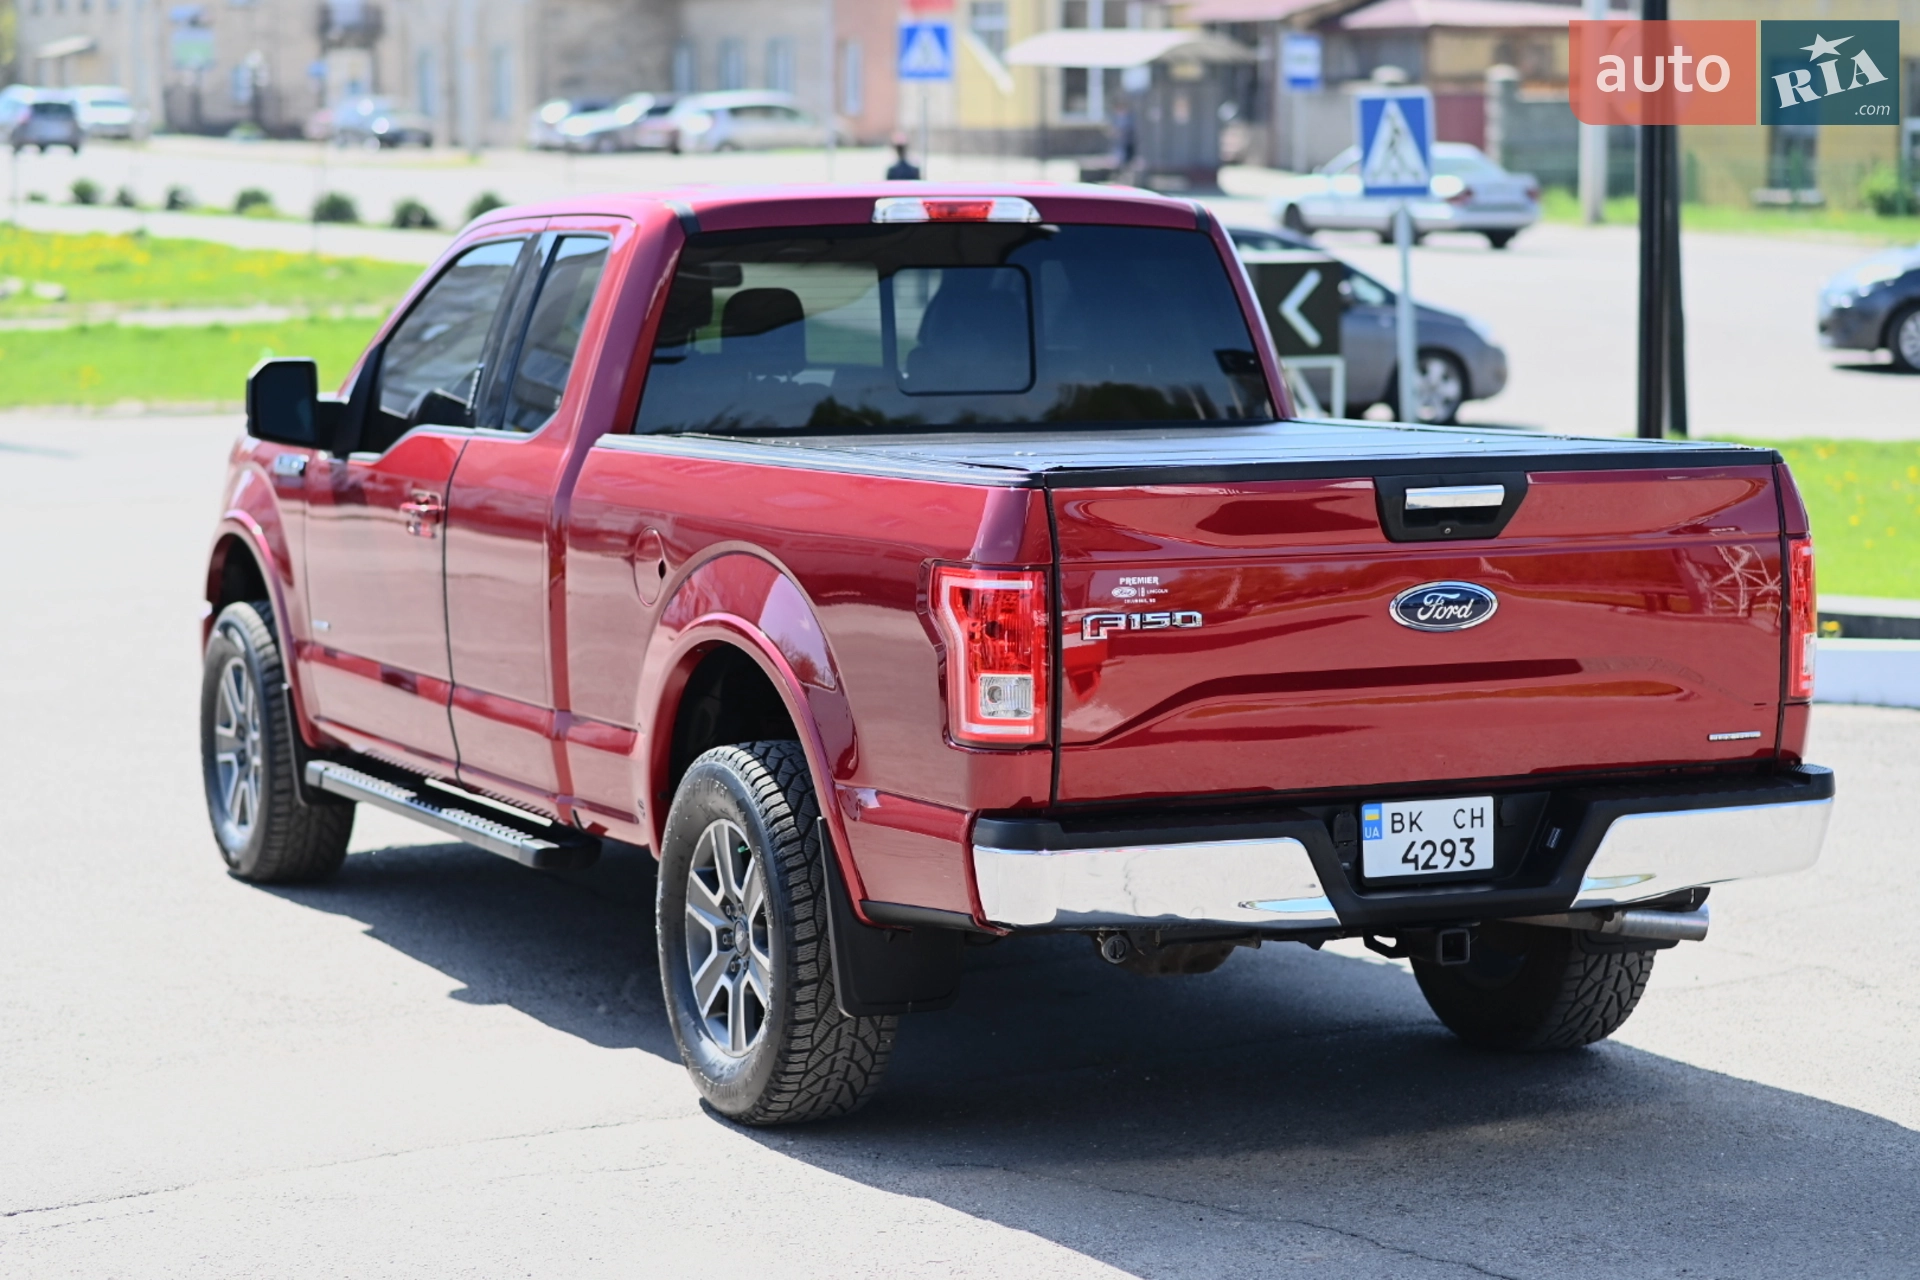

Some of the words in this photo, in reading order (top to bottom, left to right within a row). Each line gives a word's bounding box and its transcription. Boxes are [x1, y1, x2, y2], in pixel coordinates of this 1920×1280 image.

[1119, 576, 1160, 586] PREMIER
[1417, 592, 1473, 621] Ford
[1364, 826, 1380, 839] UA
[1391, 810, 1424, 834] BK
[1453, 806, 1484, 830] CH
[1401, 837, 1476, 871] 4293
